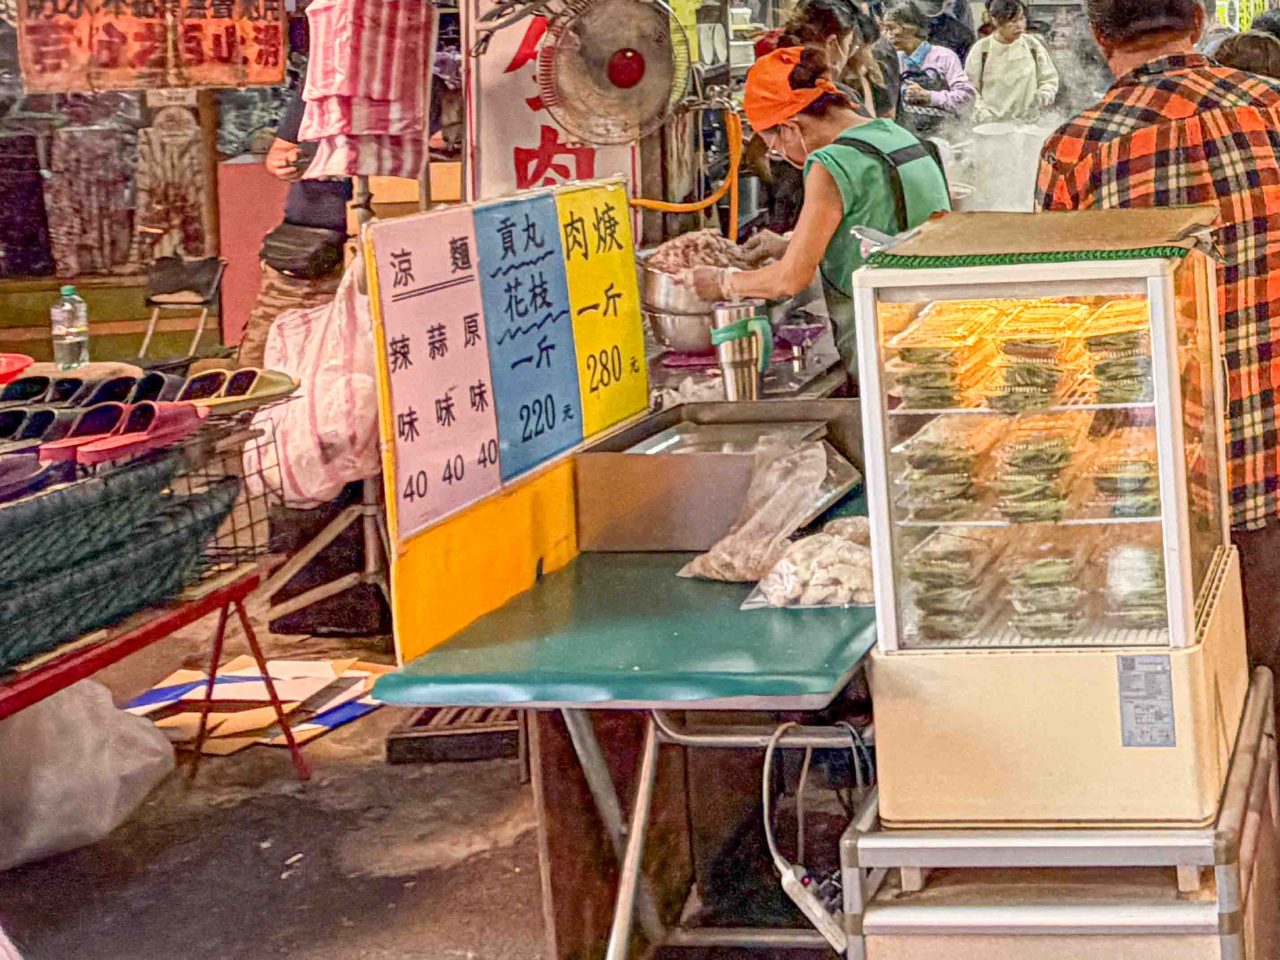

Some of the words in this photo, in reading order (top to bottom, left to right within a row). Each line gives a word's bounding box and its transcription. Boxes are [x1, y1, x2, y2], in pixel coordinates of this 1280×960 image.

[497, 213, 545, 261] 貢丸
[563, 202, 624, 262] 肉焿
[390, 236, 472, 288] 涼麵
[503, 273, 553, 324] 花枝
[577, 282, 623, 319] 一斤
[511, 335, 556, 370] 一斤
[586, 344, 622, 394] 280
[519, 394, 556, 443] 220
[402, 470, 428, 503] 40
[442, 454, 464, 486] 40
[478, 438, 498, 468] 40
